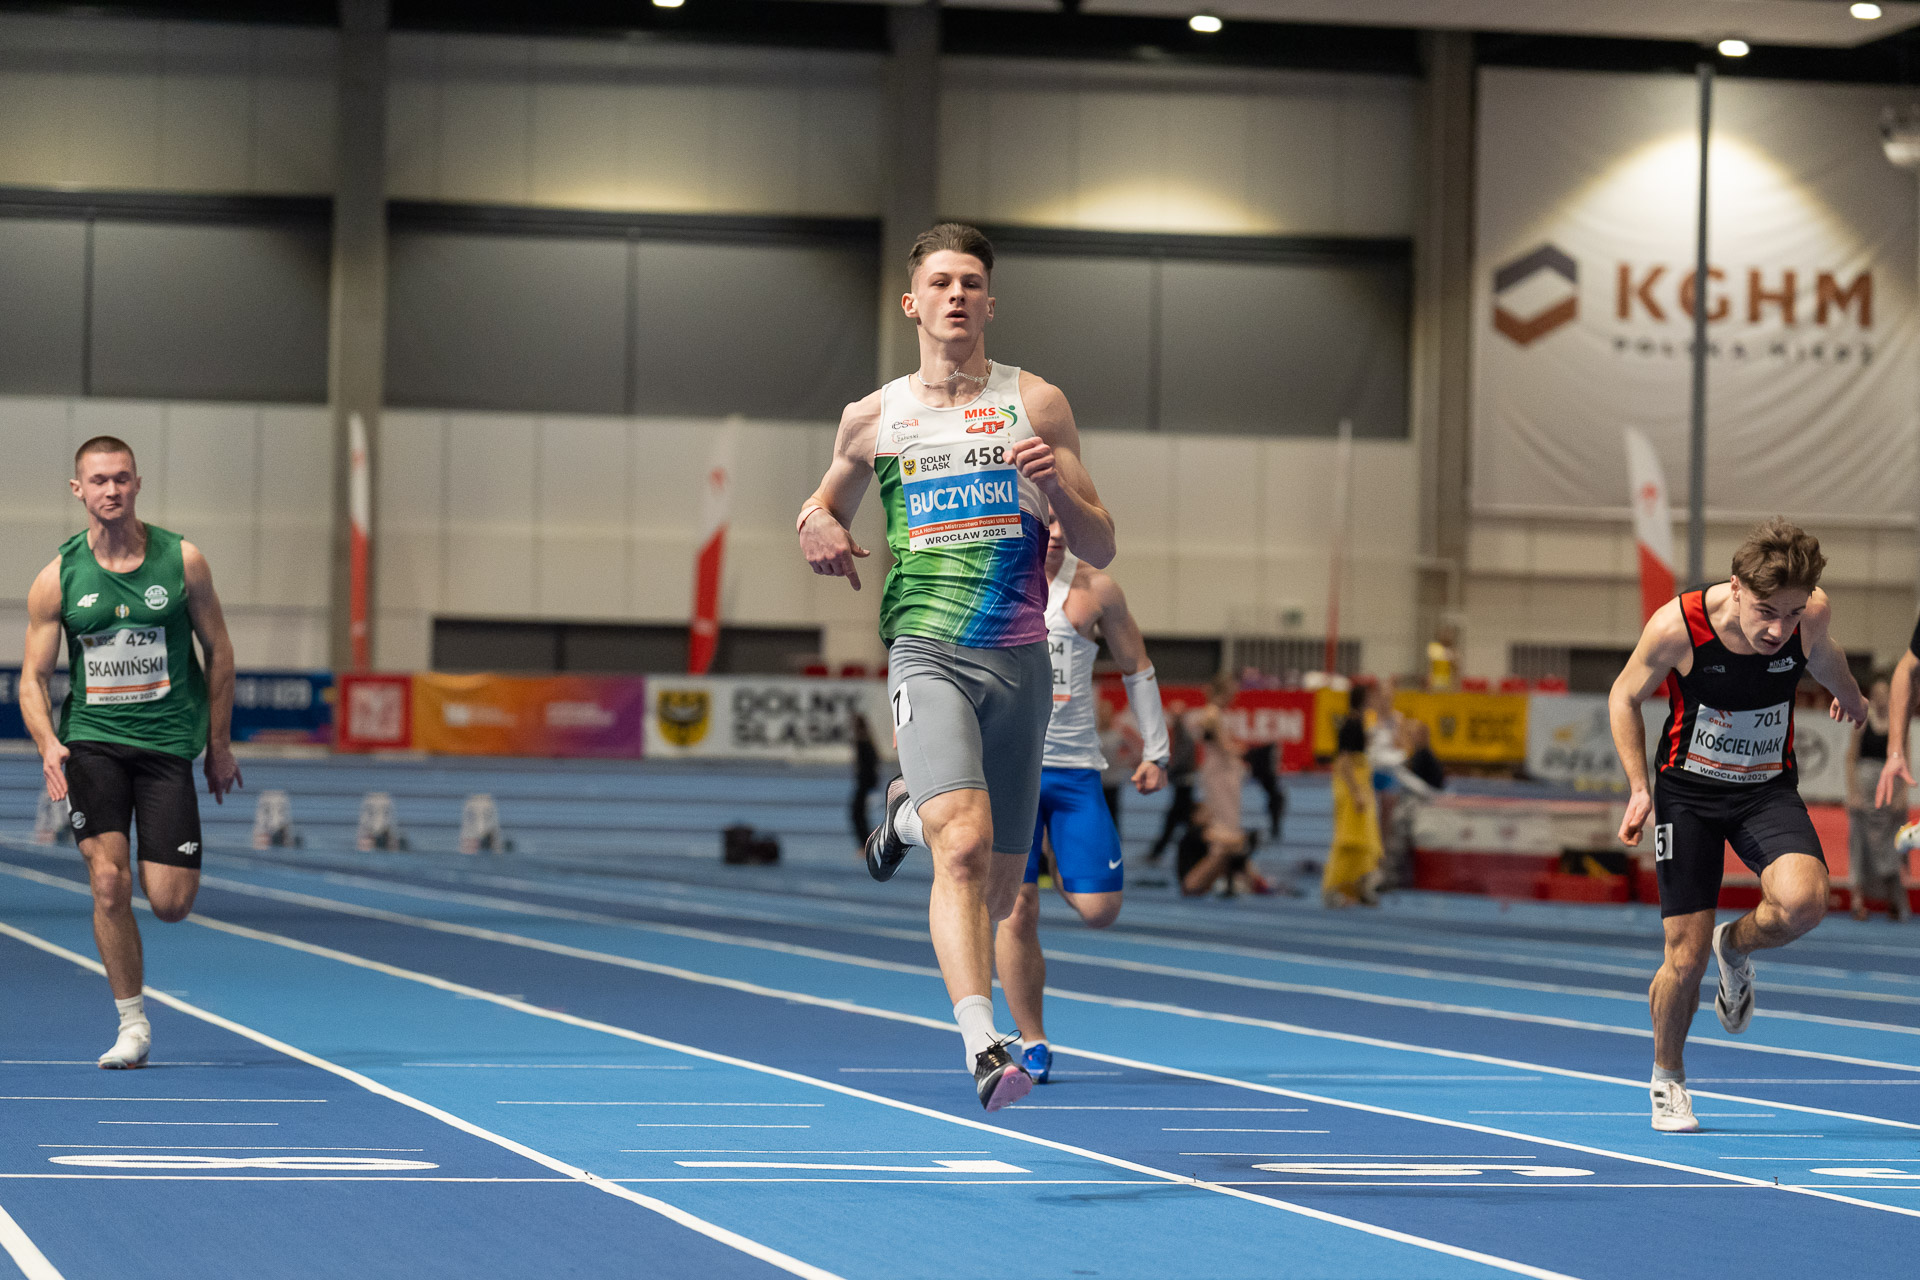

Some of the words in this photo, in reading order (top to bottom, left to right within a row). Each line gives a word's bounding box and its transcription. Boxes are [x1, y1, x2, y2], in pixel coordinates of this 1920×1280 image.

[1615, 262, 1875, 329] KGHM
[965, 407, 996, 419] MKS
[920, 453, 951, 465] DOLNY
[964, 445, 1006, 467] 458
[921, 462, 951, 473] ŚLĄSK
[909, 478, 1013, 516] BUCZYŃSKI
[925, 531, 980, 545] WROCŁAW
[982, 528, 1007, 538] 2025
[77, 592, 99, 608] 4F
[126, 631, 158, 647] 429
[88, 655, 164, 677] SKAWIŃSKI
[98, 694, 138, 703] WROCŁAW
[139, 692, 158, 700] 2025
[734, 687, 861, 713] DOLNY
[1708, 717, 1733, 729] ORLEN
[1753, 709, 1782, 729] 701
[1695, 729, 1784, 757] KOŚCIELNIAK
[1699, 766, 1747, 782] WROCŁAW
[1747, 773, 1768, 782] 2025
[177, 841, 200, 856] 4F
[1656, 827, 1667, 857] 5
